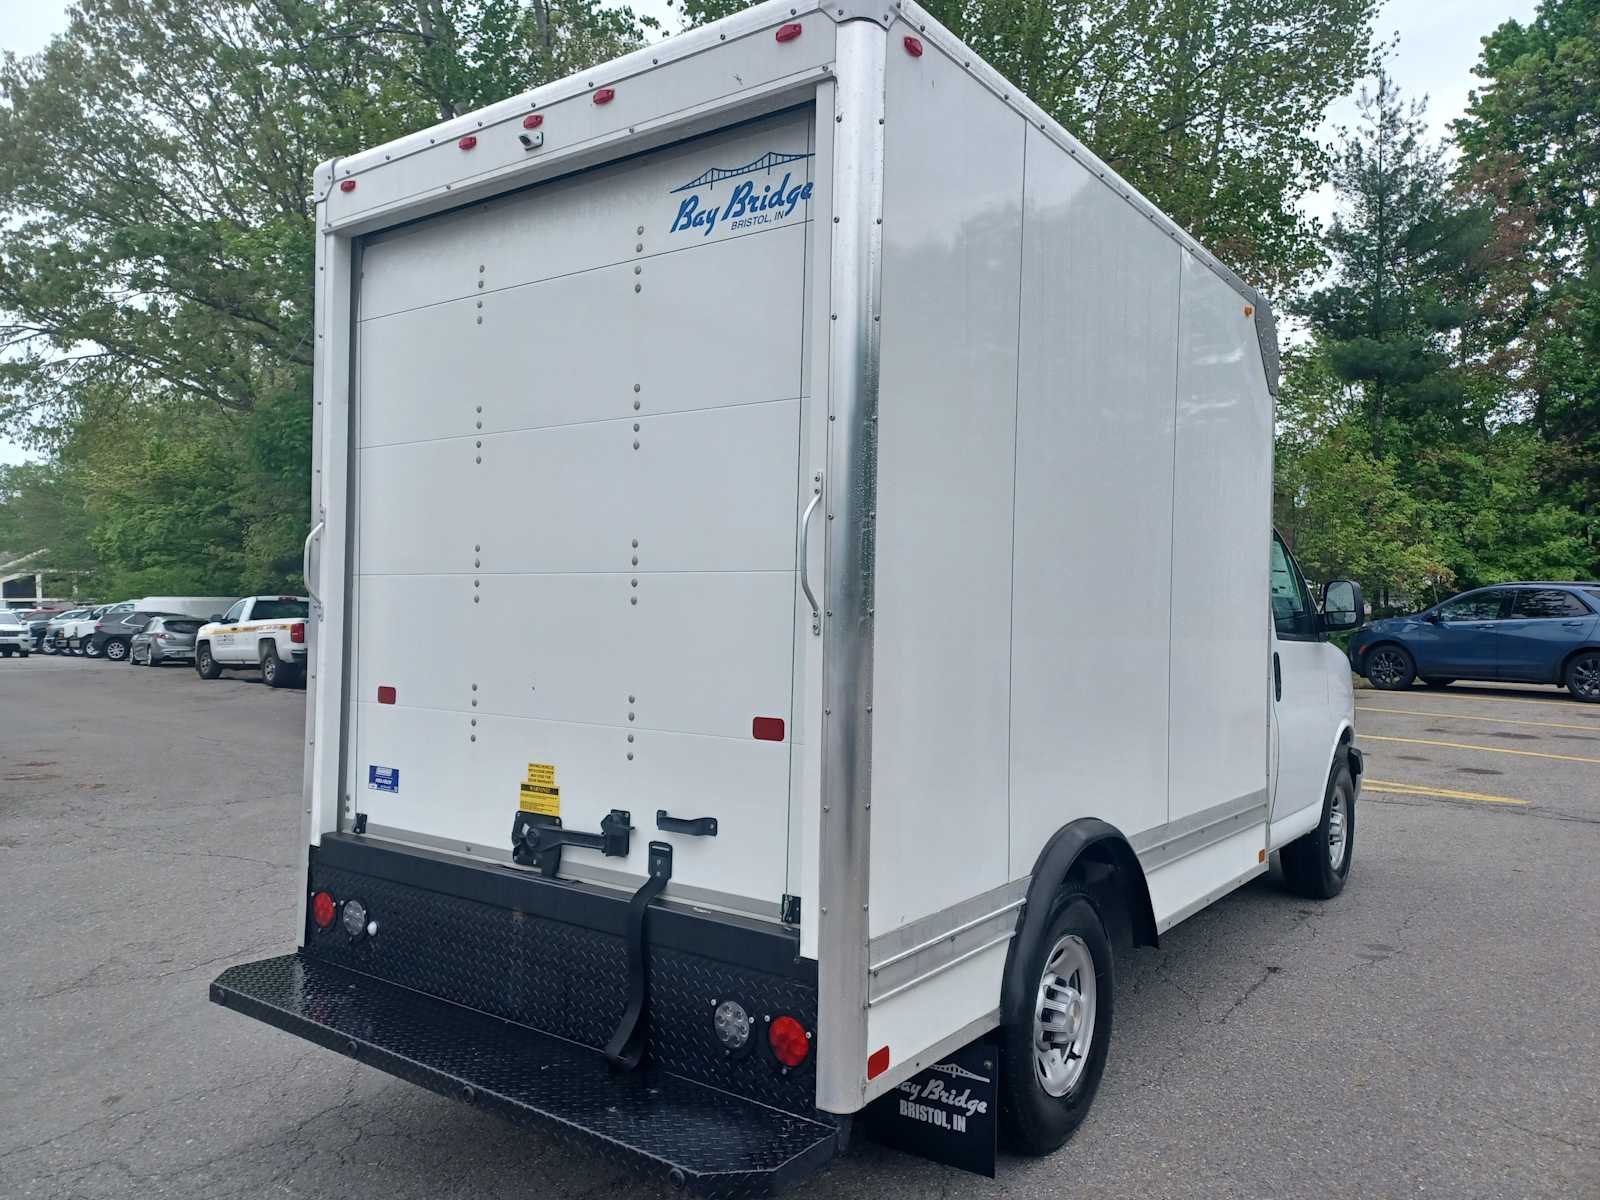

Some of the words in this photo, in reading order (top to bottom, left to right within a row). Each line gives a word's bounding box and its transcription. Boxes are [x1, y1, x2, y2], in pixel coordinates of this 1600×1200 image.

[669, 195, 720, 236] Bay
[721, 172, 814, 221] Bridge
[731, 213, 772, 231] BRISTOL,
[774, 211, 786, 221] IN
[896, 1081, 921, 1100] ay
[921, 1079, 988, 1116] Bridge
[900, 1099, 951, 1130] BRISTOL,
[953, 1113, 966, 1132] IN
